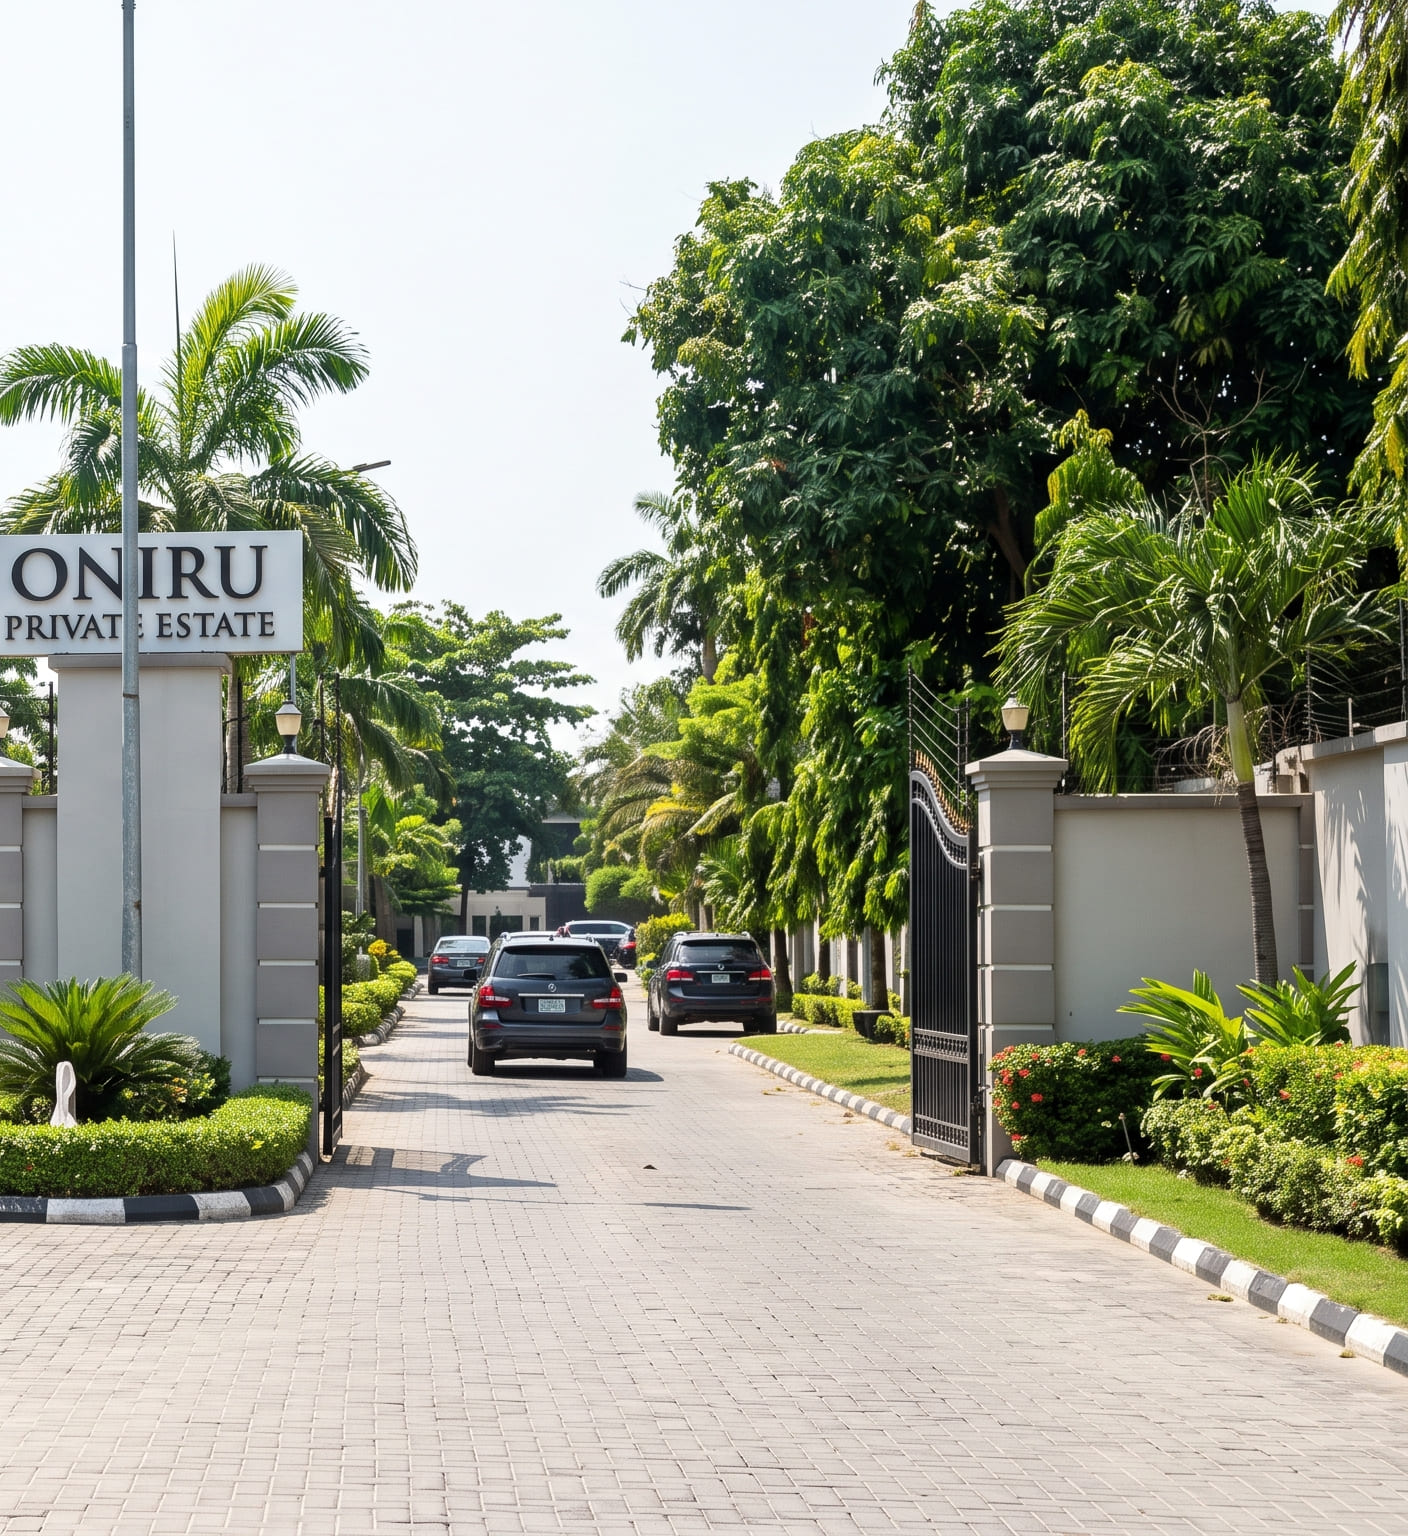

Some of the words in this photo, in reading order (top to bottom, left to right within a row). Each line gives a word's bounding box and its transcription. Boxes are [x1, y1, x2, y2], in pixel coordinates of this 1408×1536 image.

[11, 545, 268, 601] ONIRU
[4, 613, 144, 640] PRIVAT
[156, 611, 275, 638] ESTATE
